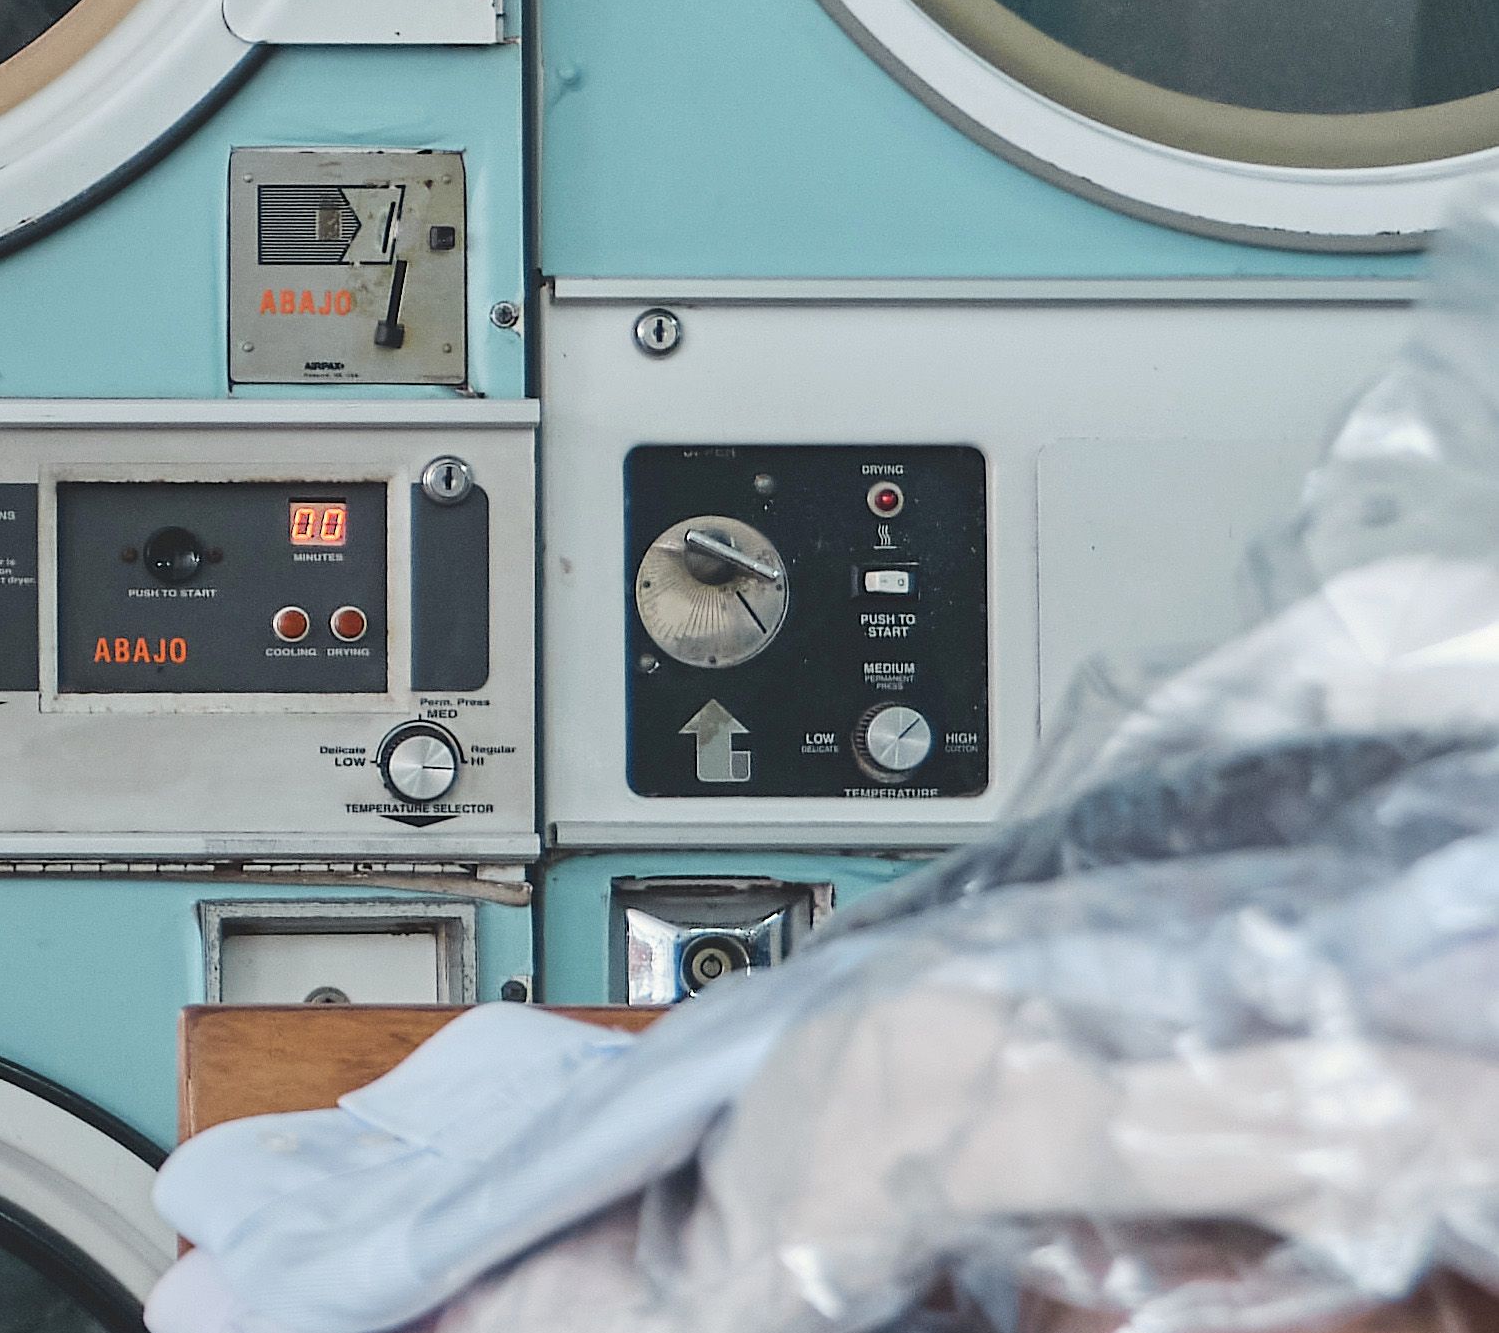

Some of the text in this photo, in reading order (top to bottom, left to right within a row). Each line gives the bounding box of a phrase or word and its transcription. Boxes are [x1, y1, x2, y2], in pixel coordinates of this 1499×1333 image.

[260, 289, 352, 315] ABAJO
[862, 465, 903, 475] DRYING
[292, 507, 345, 541] 00
[293, 553, 343, 562] MINUTES
[128, 589, 216, 597] PUSH TO START
[861, 614, 915, 625] PUSH TO
[868, 627, 908, 637] START
[94, 638, 188, 663] ABAJO
[266, 648, 317, 657] COOLING
[327, 648, 369, 657] DRYING
[864, 663, 915, 673] MEDIUM
[420, 698, 490, 707] Perm. Press
[427, 709, 458, 718] MED
[806, 734, 834, 744] LOW
[946, 734, 976, 743] HIGH
[320, 745, 366, 754] Delicate
[471, 745, 515, 754] Regular
[335, 757, 366, 766] LOW
[471, 757, 484, 765] HI
[345, 804, 493, 813] TEMPERATURE SELECTOR
